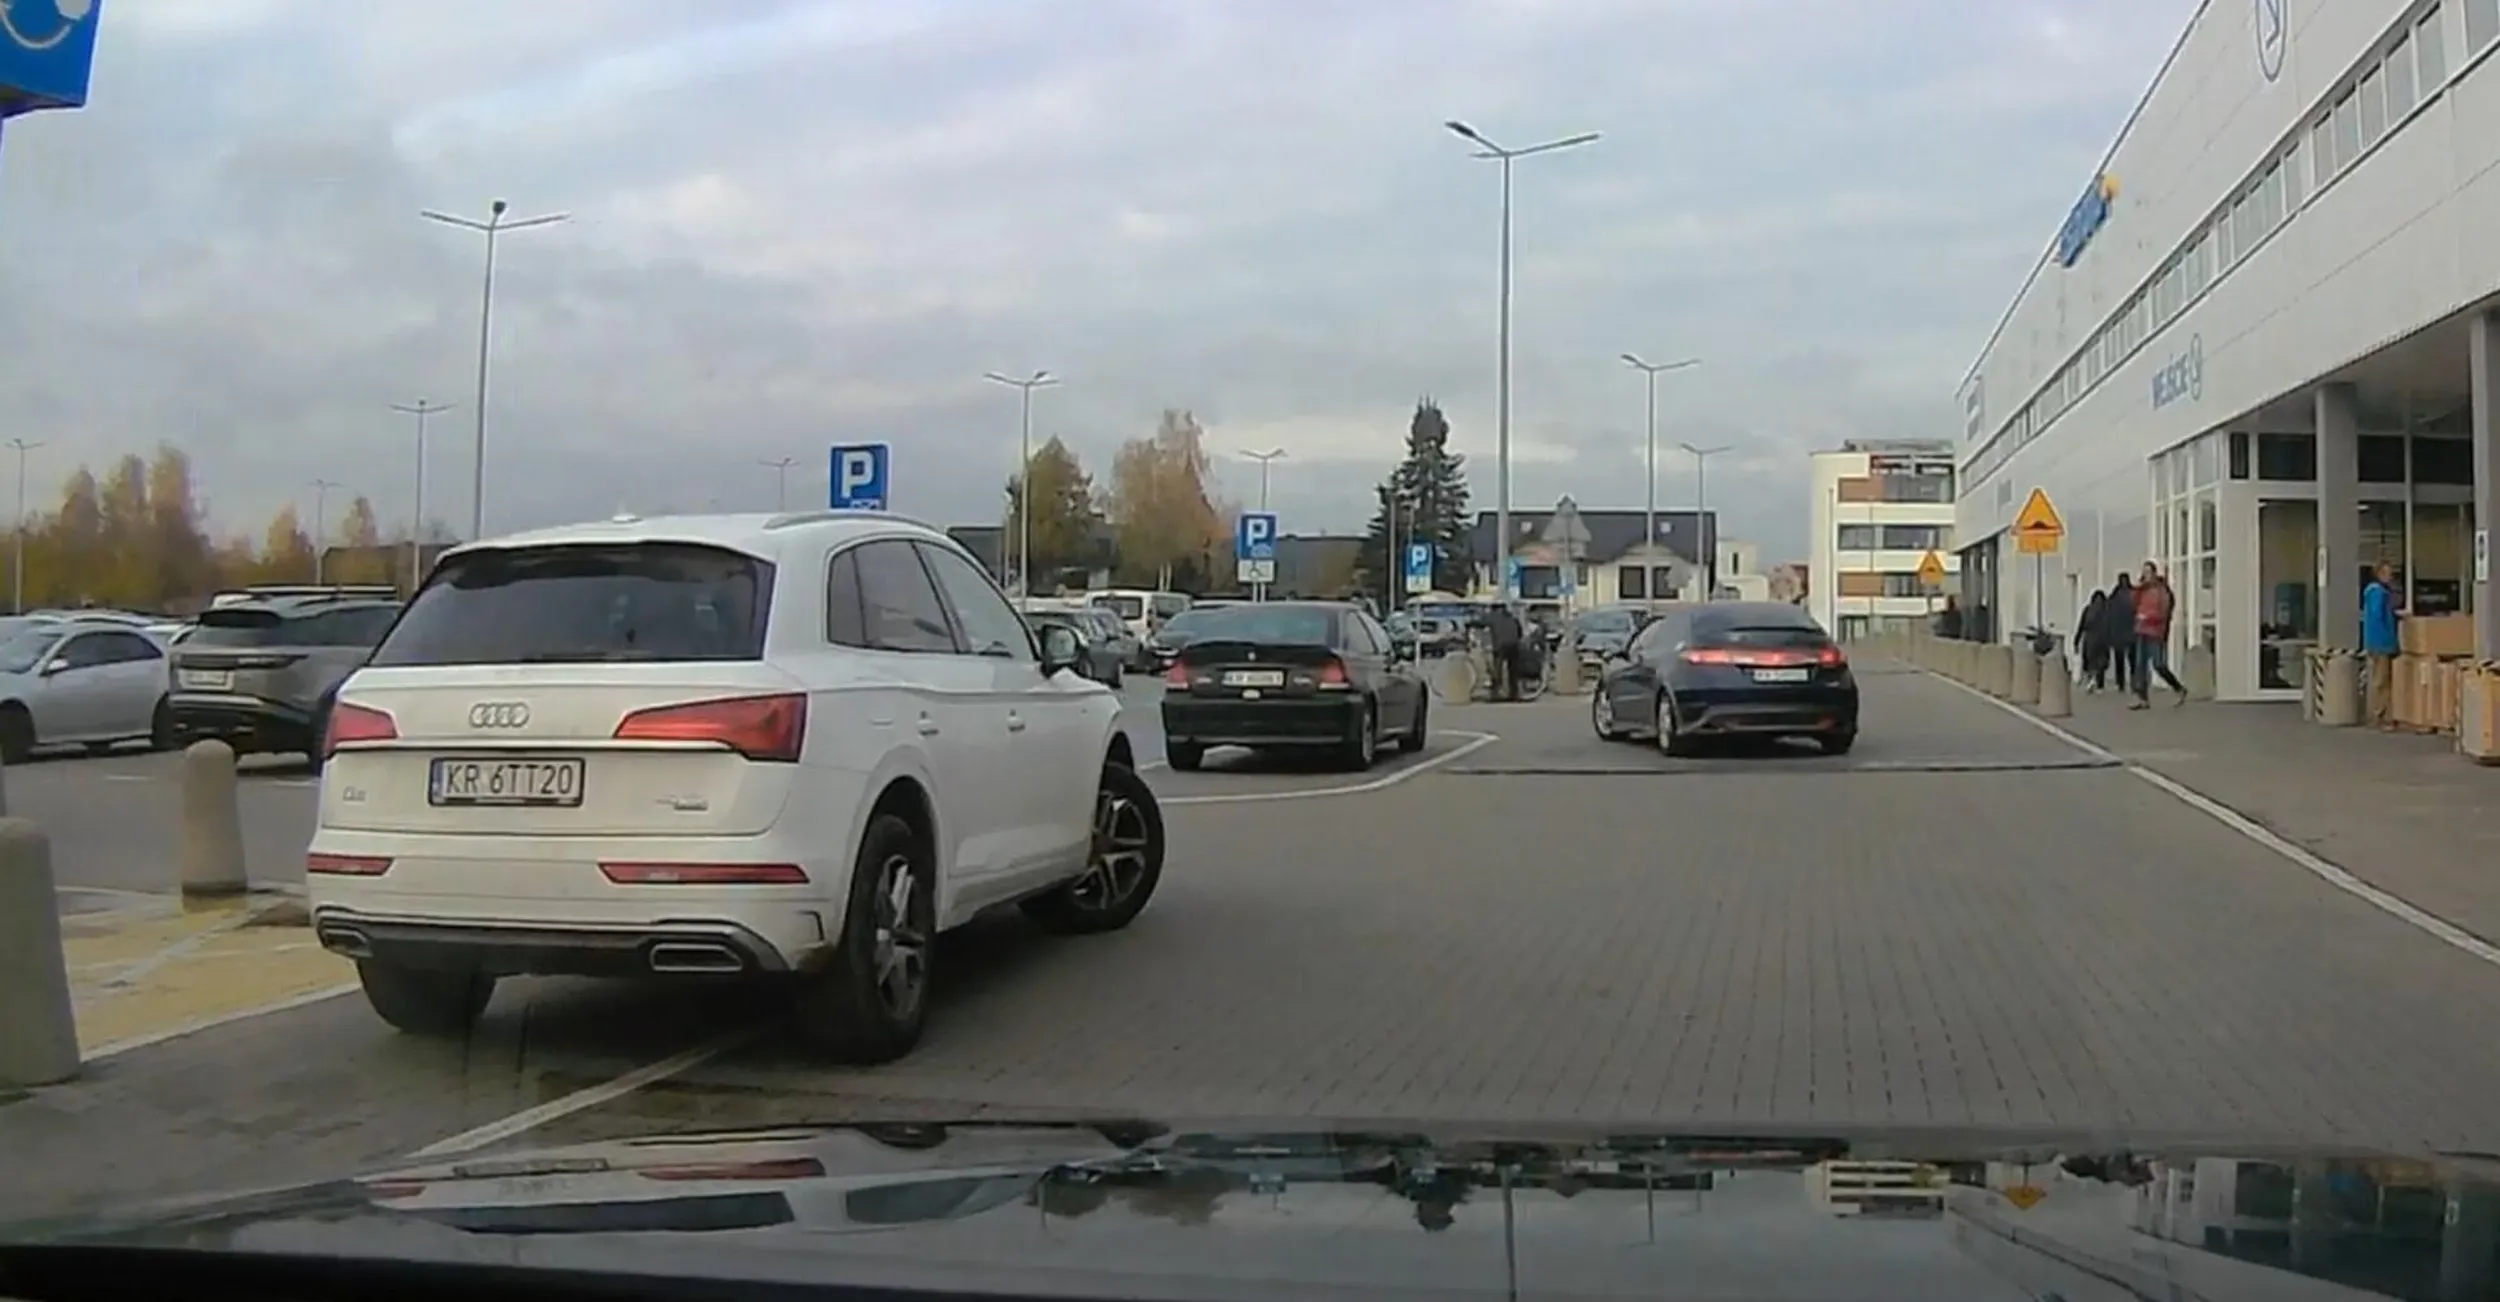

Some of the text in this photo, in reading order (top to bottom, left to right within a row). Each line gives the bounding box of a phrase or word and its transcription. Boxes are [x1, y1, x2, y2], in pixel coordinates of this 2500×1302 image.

[841, 450, 874, 499] P
[1247, 518, 1268, 546] P
[1412, 546, 1427, 565] P
[446, 764, 573, 795] KR 6TT20
